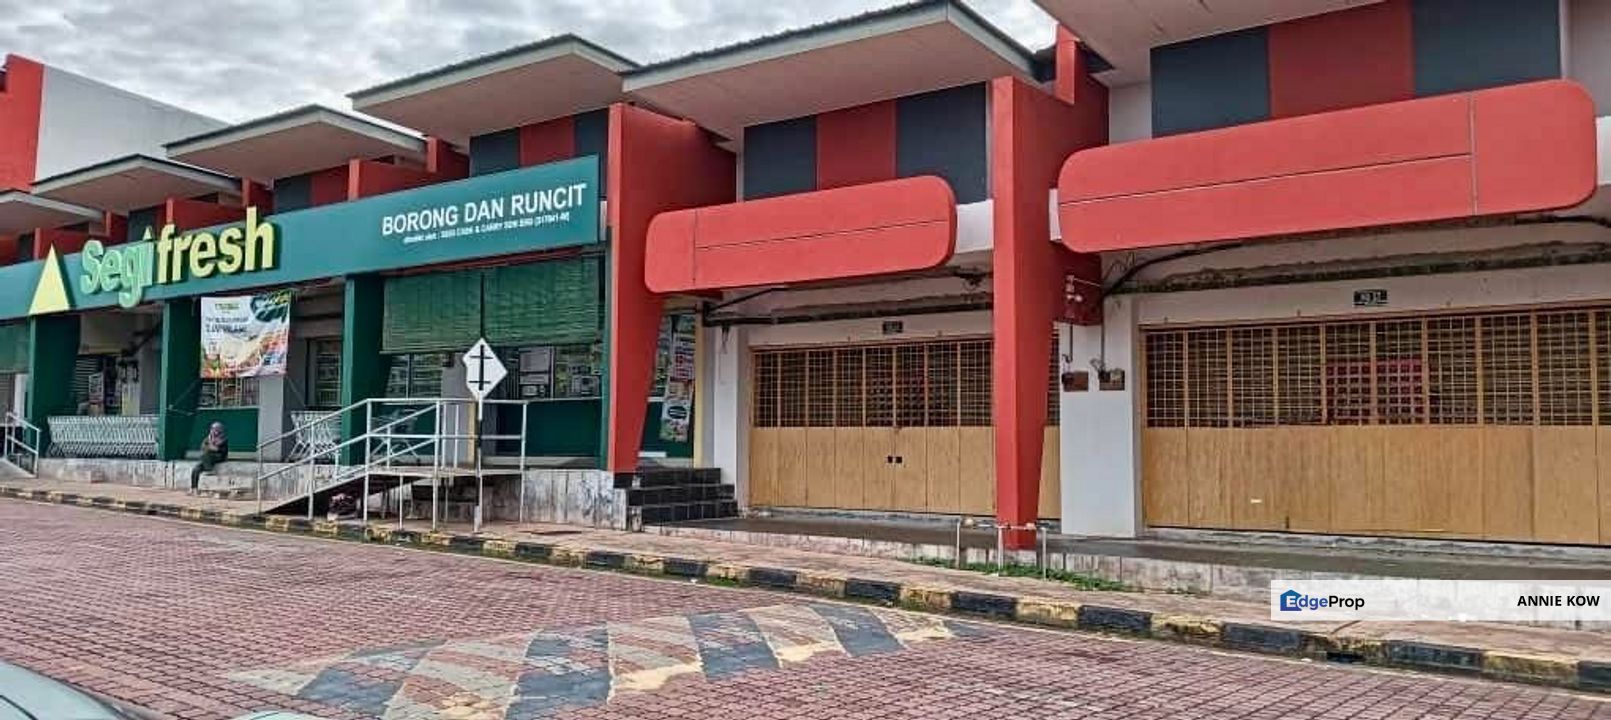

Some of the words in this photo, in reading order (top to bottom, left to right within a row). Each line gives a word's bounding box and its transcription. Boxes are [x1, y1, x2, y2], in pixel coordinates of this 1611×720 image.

[381, 205, 459, 236] BORONG
[464, 198, 504, 222] DAN
[511, 183, 588, 216] RUNCIT
